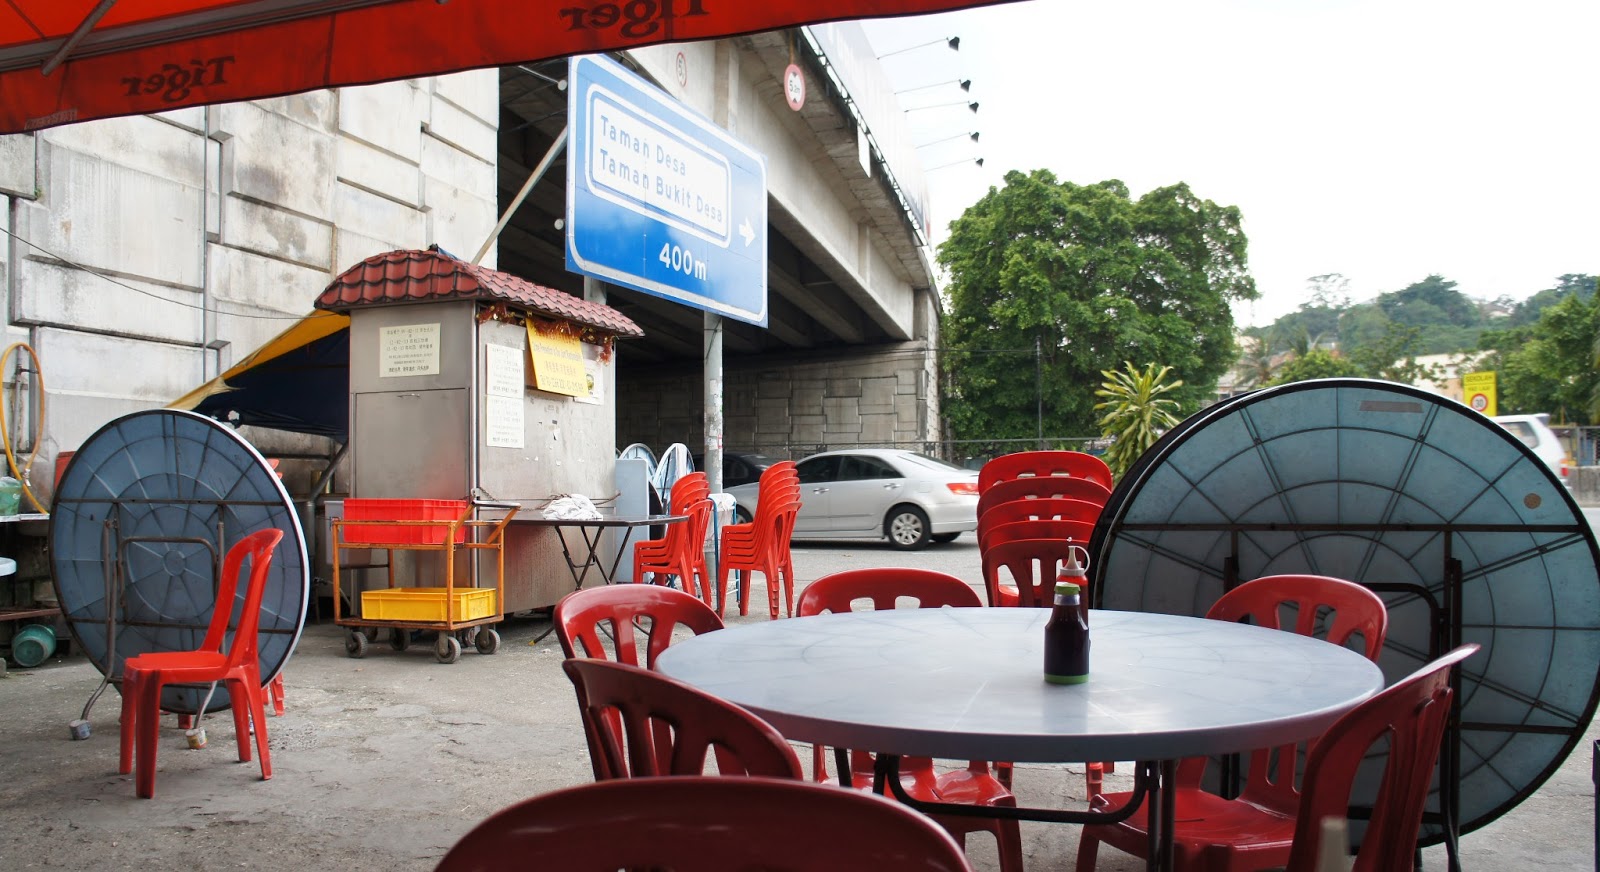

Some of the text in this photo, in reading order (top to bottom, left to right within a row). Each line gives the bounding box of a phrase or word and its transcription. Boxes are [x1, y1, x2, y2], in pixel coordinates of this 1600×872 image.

[600, 115, 686, 176] Taman Desa
[600, 148, 722, 223] Taman Bukit Desa
[659, 242, 707, 281] 400m
[1475, 399, 1484, 408] 30
